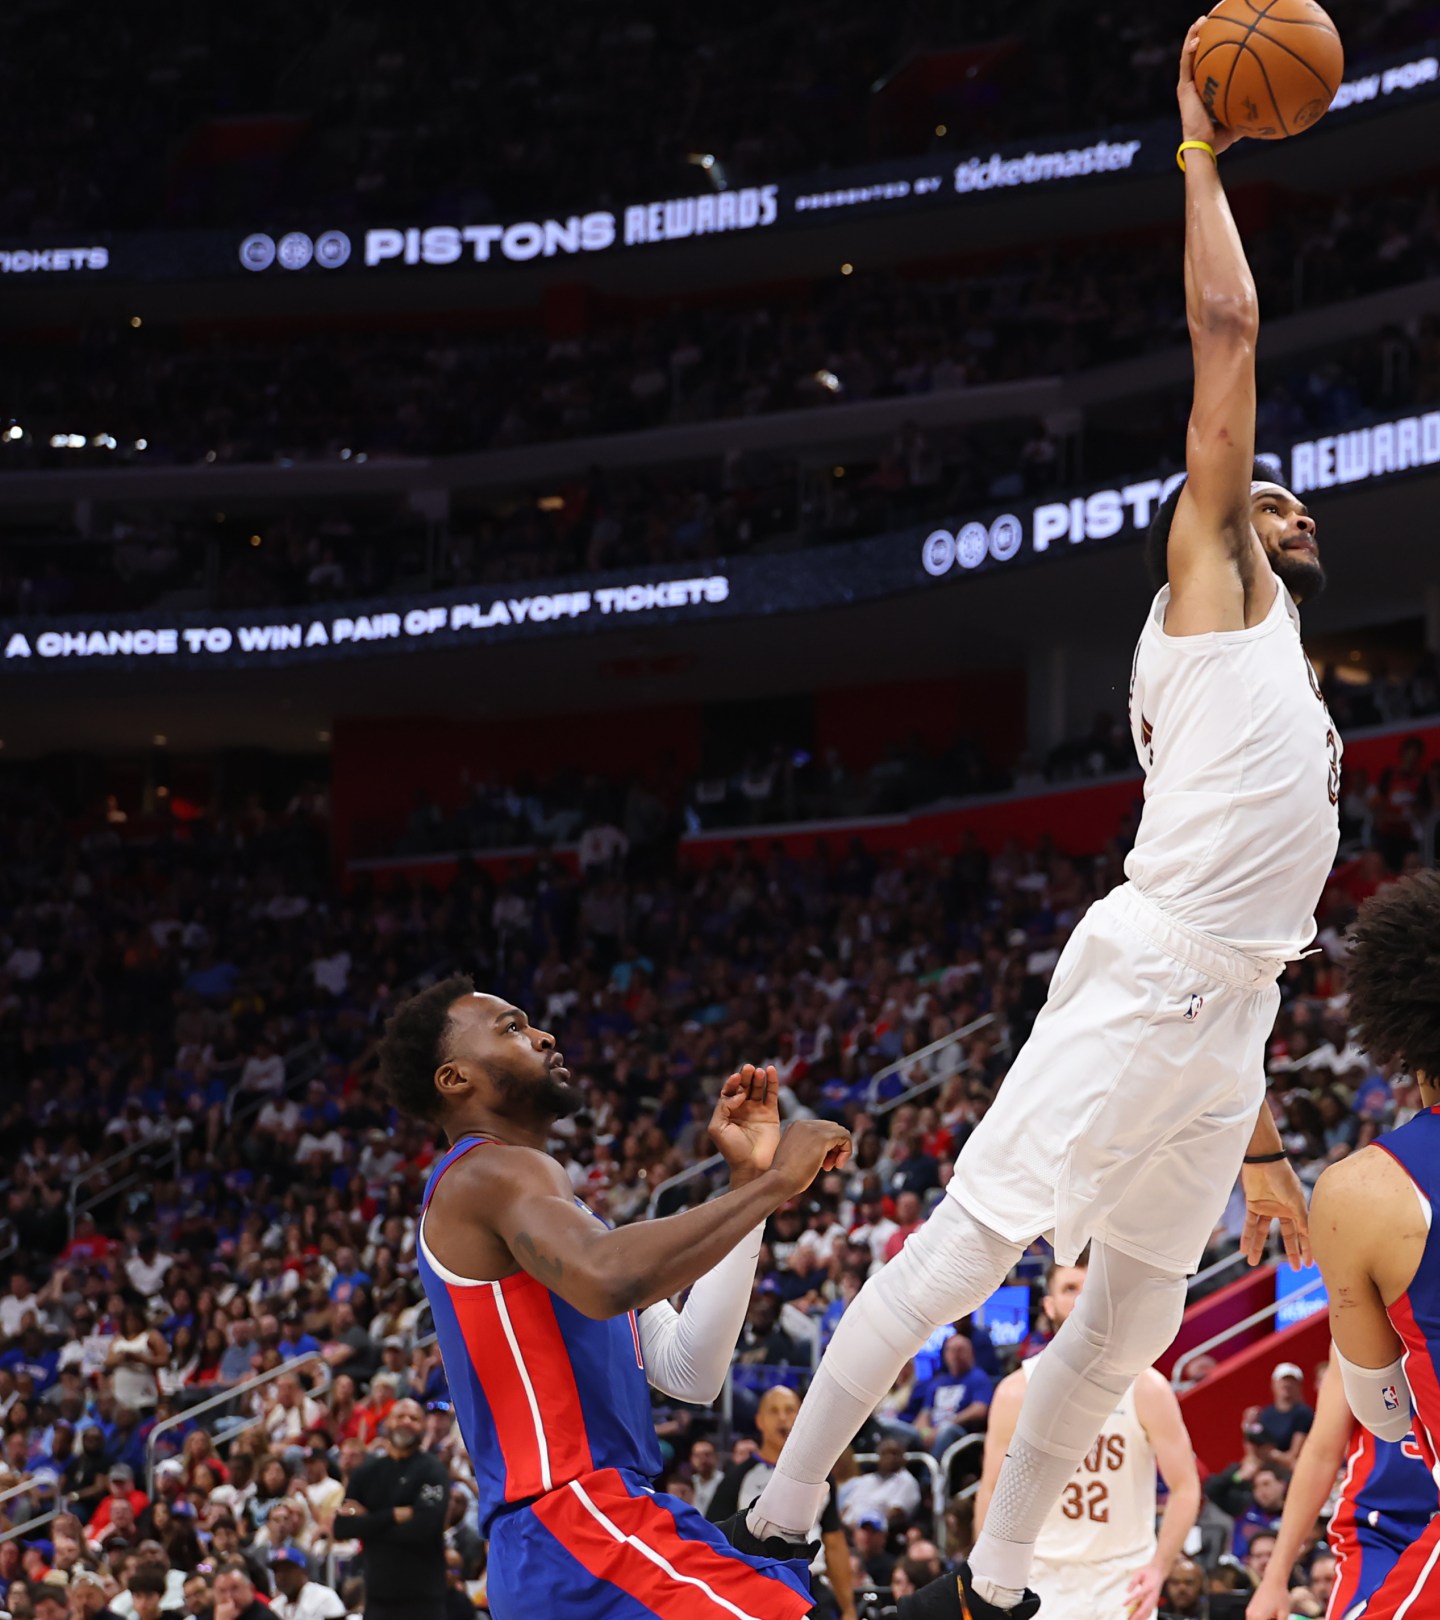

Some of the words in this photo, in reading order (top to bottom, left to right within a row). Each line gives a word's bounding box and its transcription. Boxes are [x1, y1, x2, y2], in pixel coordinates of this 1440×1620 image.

[1329, 75, 1380, 111] OW
[1382, 58, 1438, 94] FOR
[796, 182, 910, 210] PRESENTED
[914, 177, 942, 194] BY
[955, 141, 1140, 192] ticketmaster
[365, 212, 615, 265] PISTONS
[625, 185, 777, 245] REWARDS
[0, 248, 108, 272] ICKETS
[5, 634, 31, 658] A
[37, 629, 178, 657] CHANCE
[183, 628, 232, 653] TO
[238, 624, 301, 651] WIN
[305, 621, 328, 646] A
[333, 613, 401, 644] PAIR
[404, 608, 447, 635] OF
[451, 592, 591, 630] PLAYOFF
[594, 576, 729, 614] TICKETS
[1076, 1433, 1125, 1473] VS
[1062, 1481, 1109, 1523] 32
